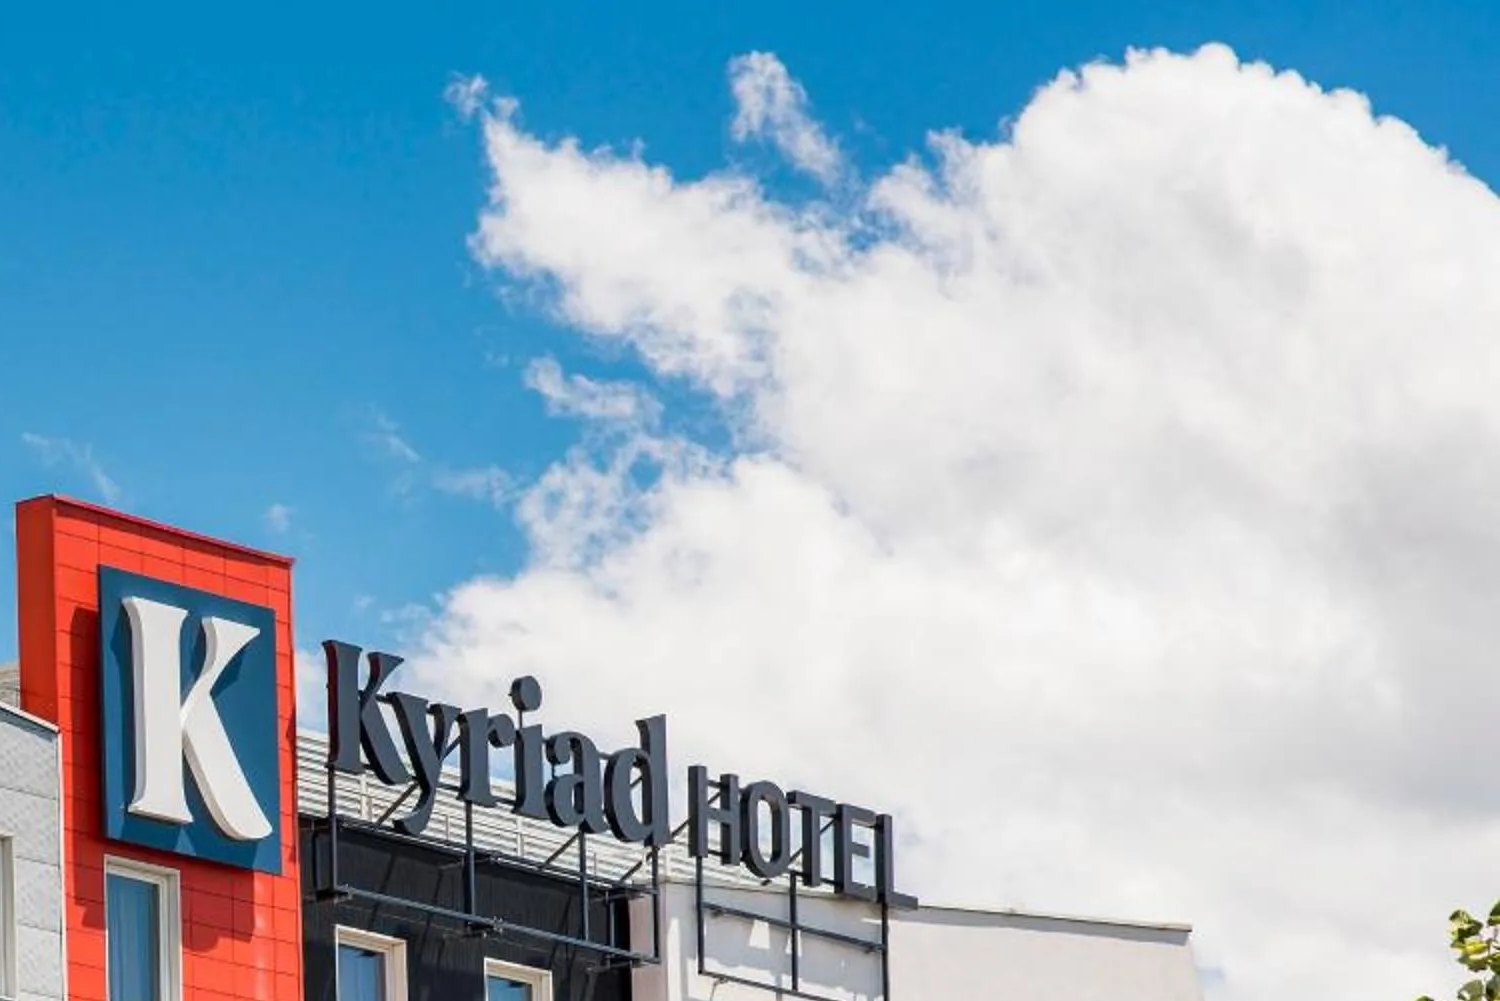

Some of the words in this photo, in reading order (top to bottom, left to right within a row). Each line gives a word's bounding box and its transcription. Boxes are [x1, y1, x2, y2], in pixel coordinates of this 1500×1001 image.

[122, 596, 273, 841] K
[323, 639, 674, 848] Kyriad
[688, 765, 918, 910] HOTEL
